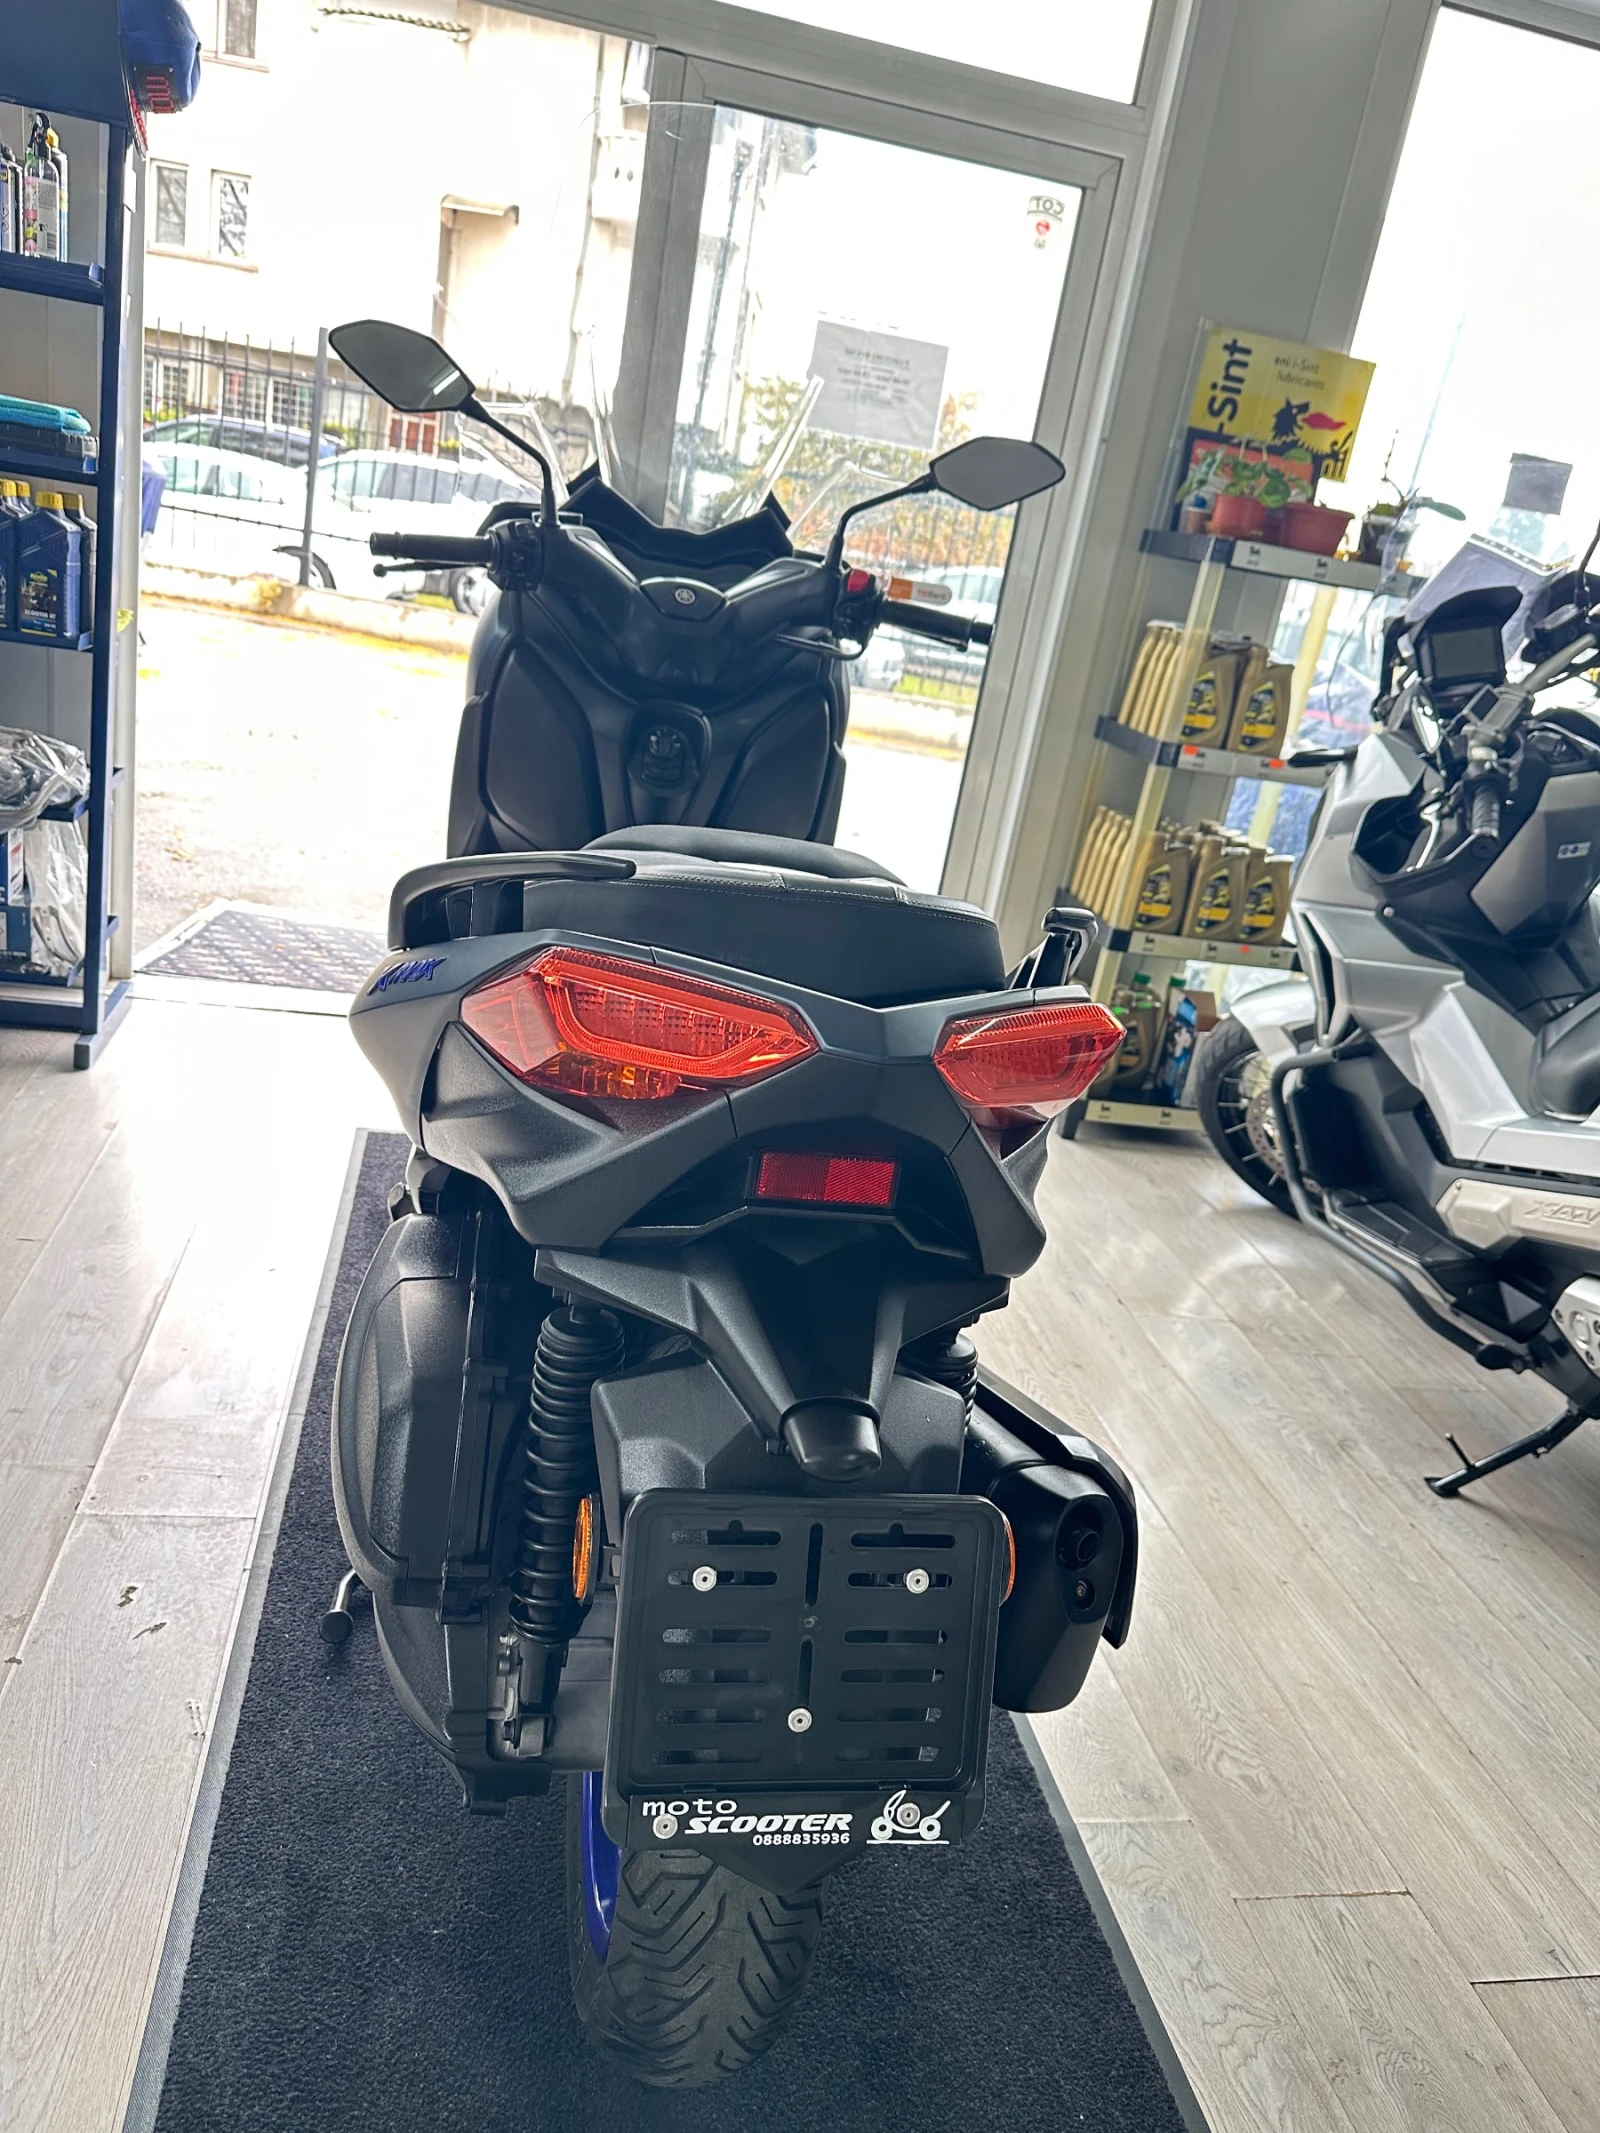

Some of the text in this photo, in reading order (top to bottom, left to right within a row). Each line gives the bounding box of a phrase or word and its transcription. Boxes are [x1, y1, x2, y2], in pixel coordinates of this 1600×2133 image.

[642, 1798, 738, 1817] moto
[684, 1813, 853, 1835] SCOOTER
[752, 1832, 851, 1846] 0888835936
